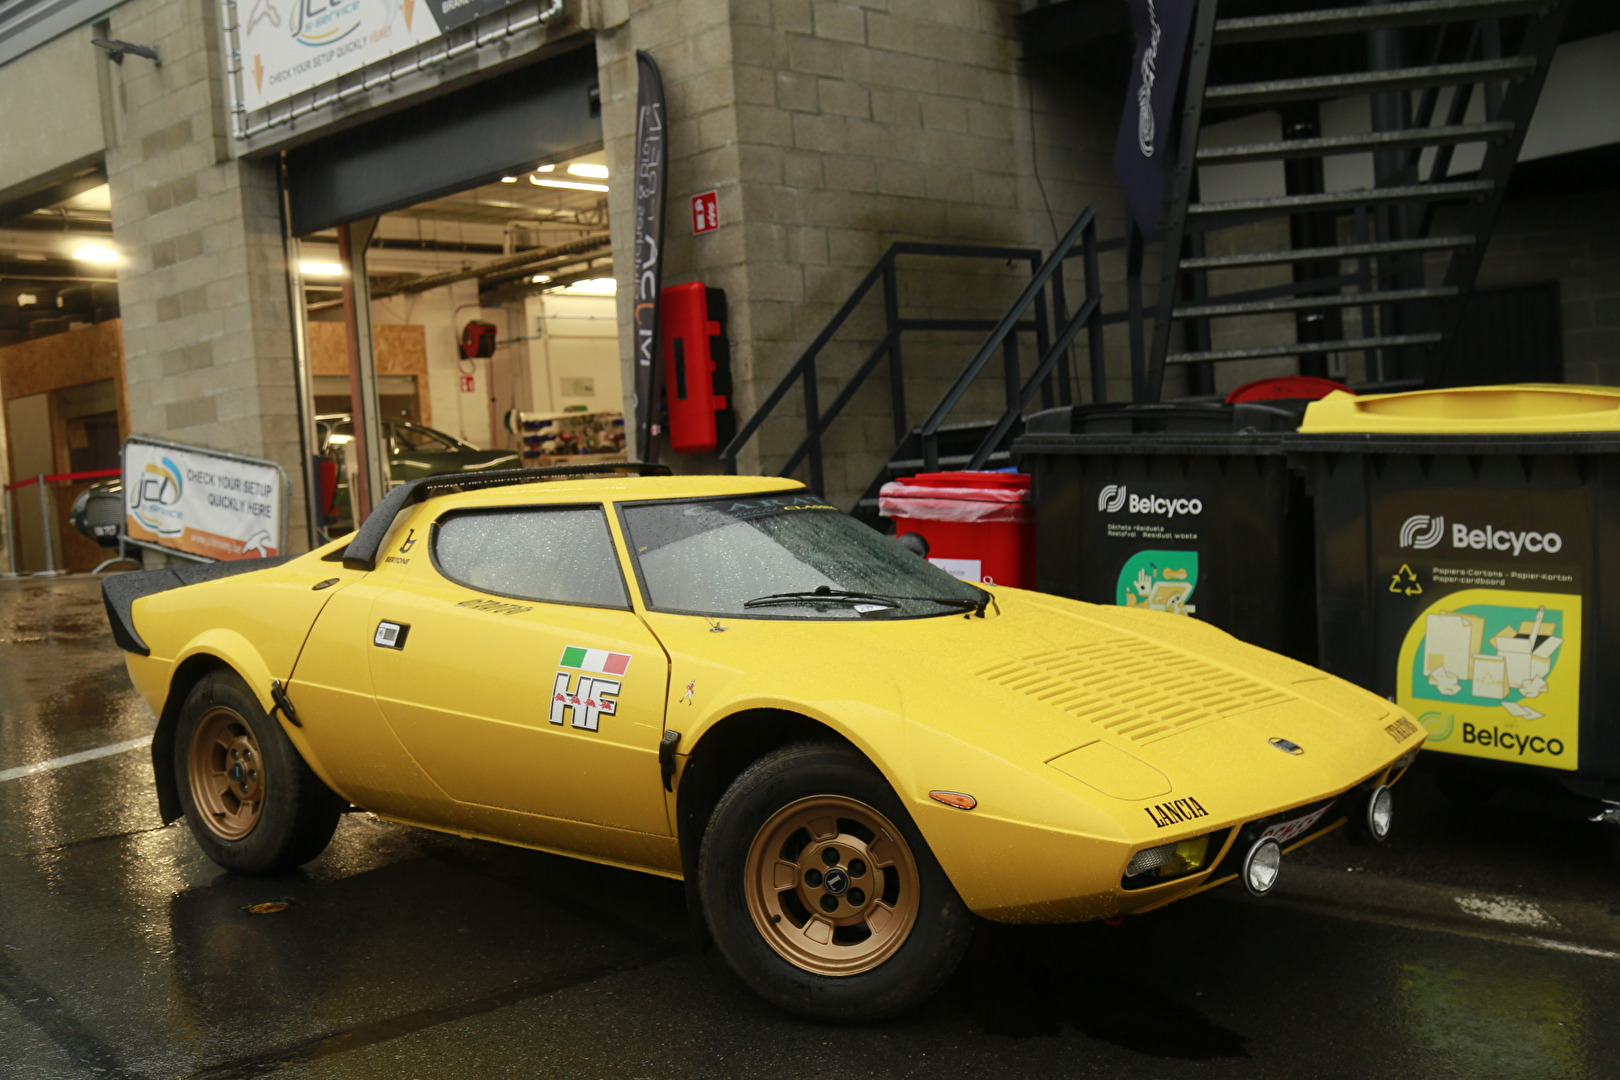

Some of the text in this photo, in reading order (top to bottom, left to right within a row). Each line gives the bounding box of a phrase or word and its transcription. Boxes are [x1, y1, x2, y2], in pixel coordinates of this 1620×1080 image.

[269, 69, 292, 86] CHECK
[292, 61, 313, 77] YOUR
[313, 50, 335, 69] SETUP
[337, 36, 368, 59] QUICKLY
[186, 468, 273, 498] CHECK YOUR SETUP
[207, 492, 273, 519] QUICKLY HERE
[1129, 494, 1203, 518] Belcyco
[1452, 523, 1563, 557] Belcyco
[548, 671, 622, 733] HF
[1462, 722, 1564, 756] Belcyco
[1144, 796, 1209, 828] LANCIA
